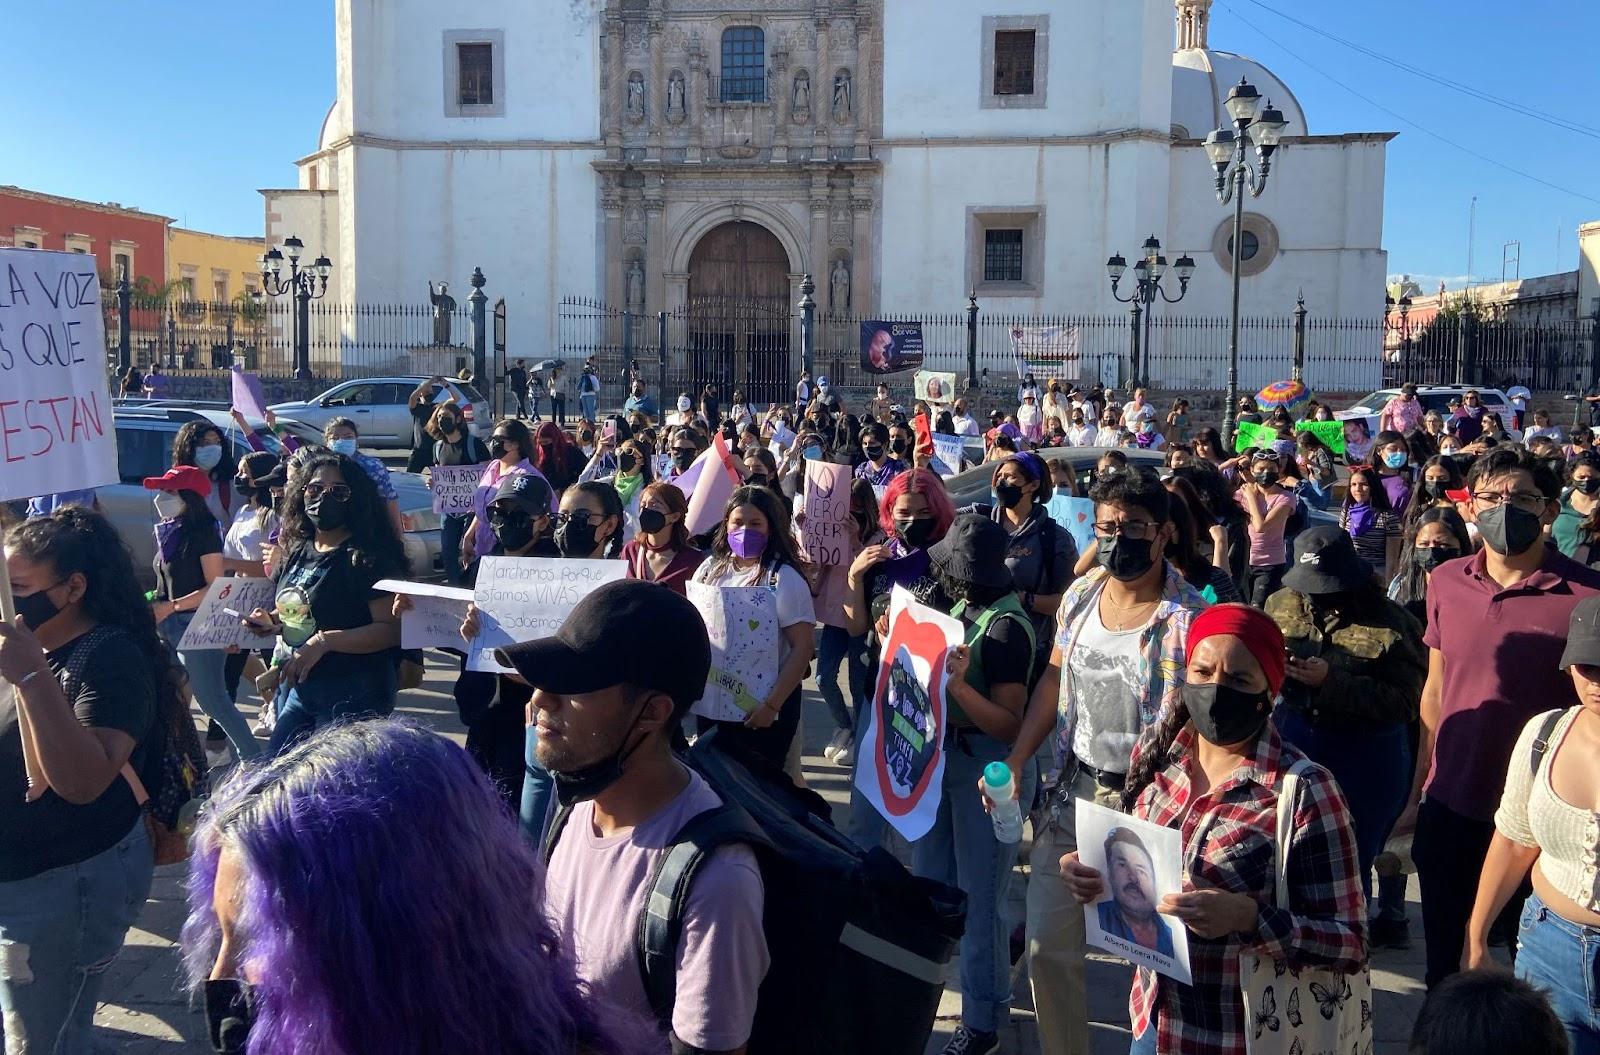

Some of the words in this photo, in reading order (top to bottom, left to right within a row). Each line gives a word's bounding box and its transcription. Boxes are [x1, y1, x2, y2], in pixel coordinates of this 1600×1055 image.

[34, 271, 96, 309] VOZ
[892, 324, 899, 336] 8
[22, 321, 85, 367] QUE
[0, 391, 103, 463] ESTAN
[459, 469, 485, 483] BAST
[450, 495, 475, 508] SEGU
[480, 558, 555, 585] Marchamos
[474, 583, 530, 603] Estamos
[535, 585, 579, 606] VIVAS
[505, 611, 563, 630] Sabemos
[715, 671, 742, 694] LIBRES
[885, 744, 914, 789] VOZ
[1104, 936, 1130, 951] Alberto
[1131, 946, 1151, 960] Loera
[1152, 954, 1171, 968] Nava
